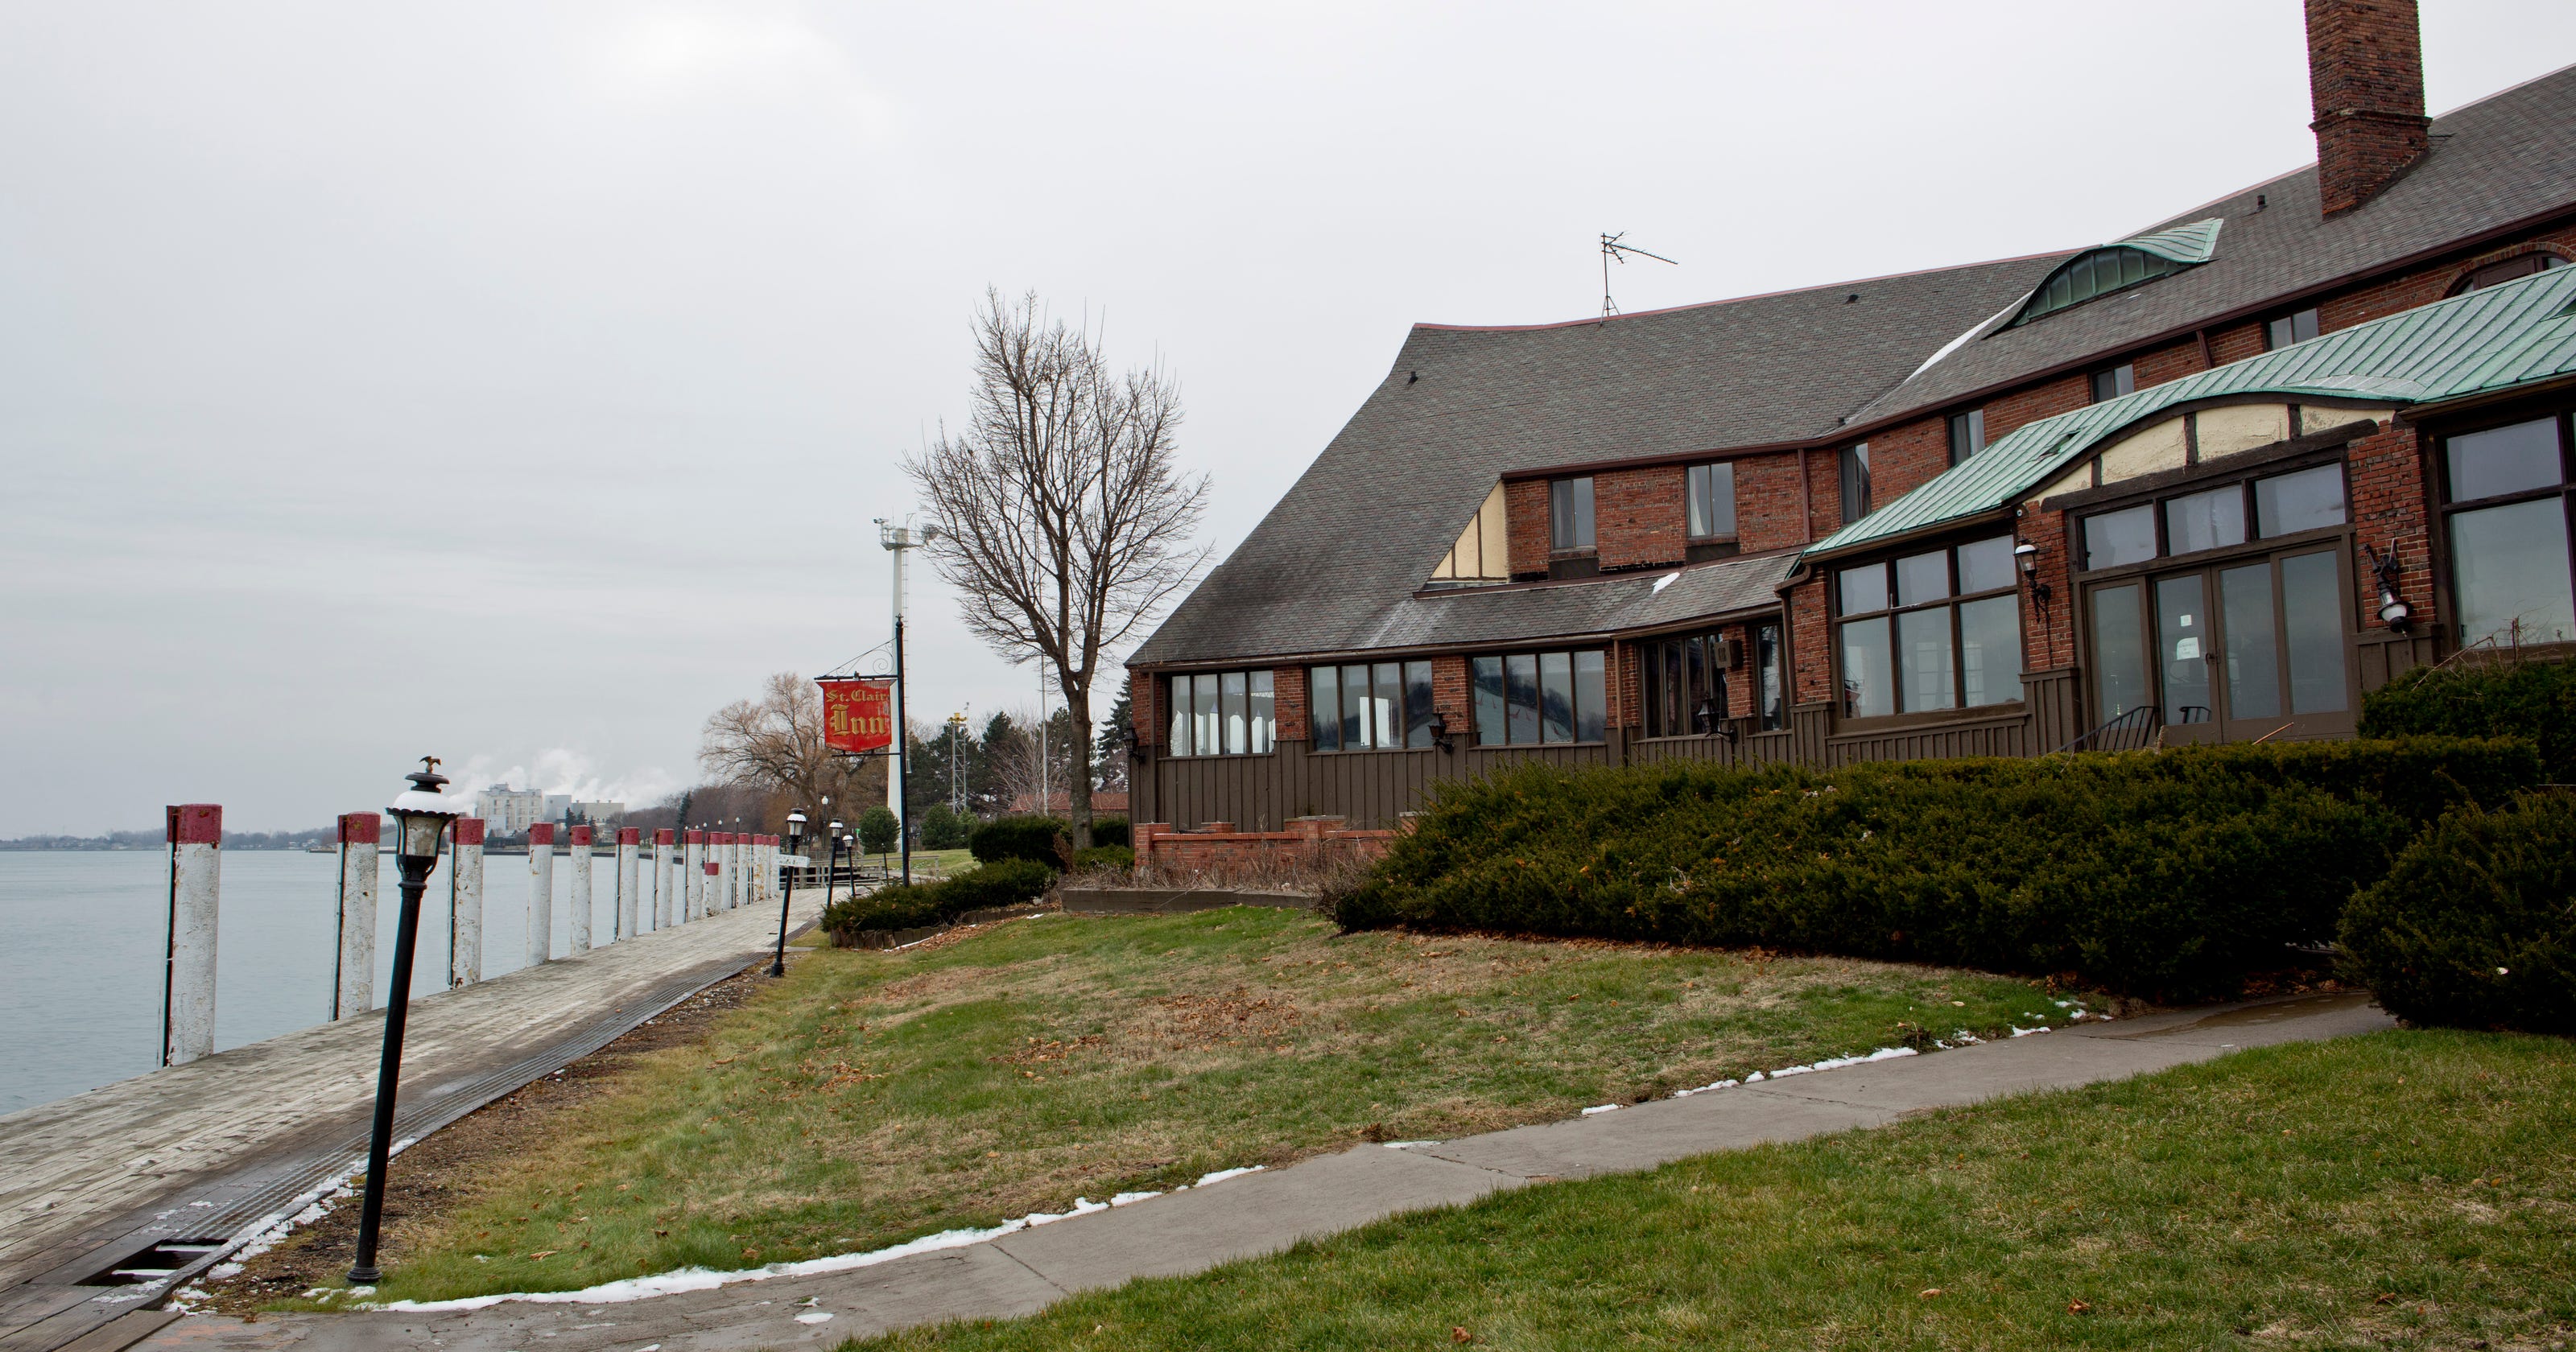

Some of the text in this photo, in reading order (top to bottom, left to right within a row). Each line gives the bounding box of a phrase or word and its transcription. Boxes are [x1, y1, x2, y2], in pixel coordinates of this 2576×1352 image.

[826, 689, 886, 703] St. Clair
[829, 704, 886, 736] Inn
